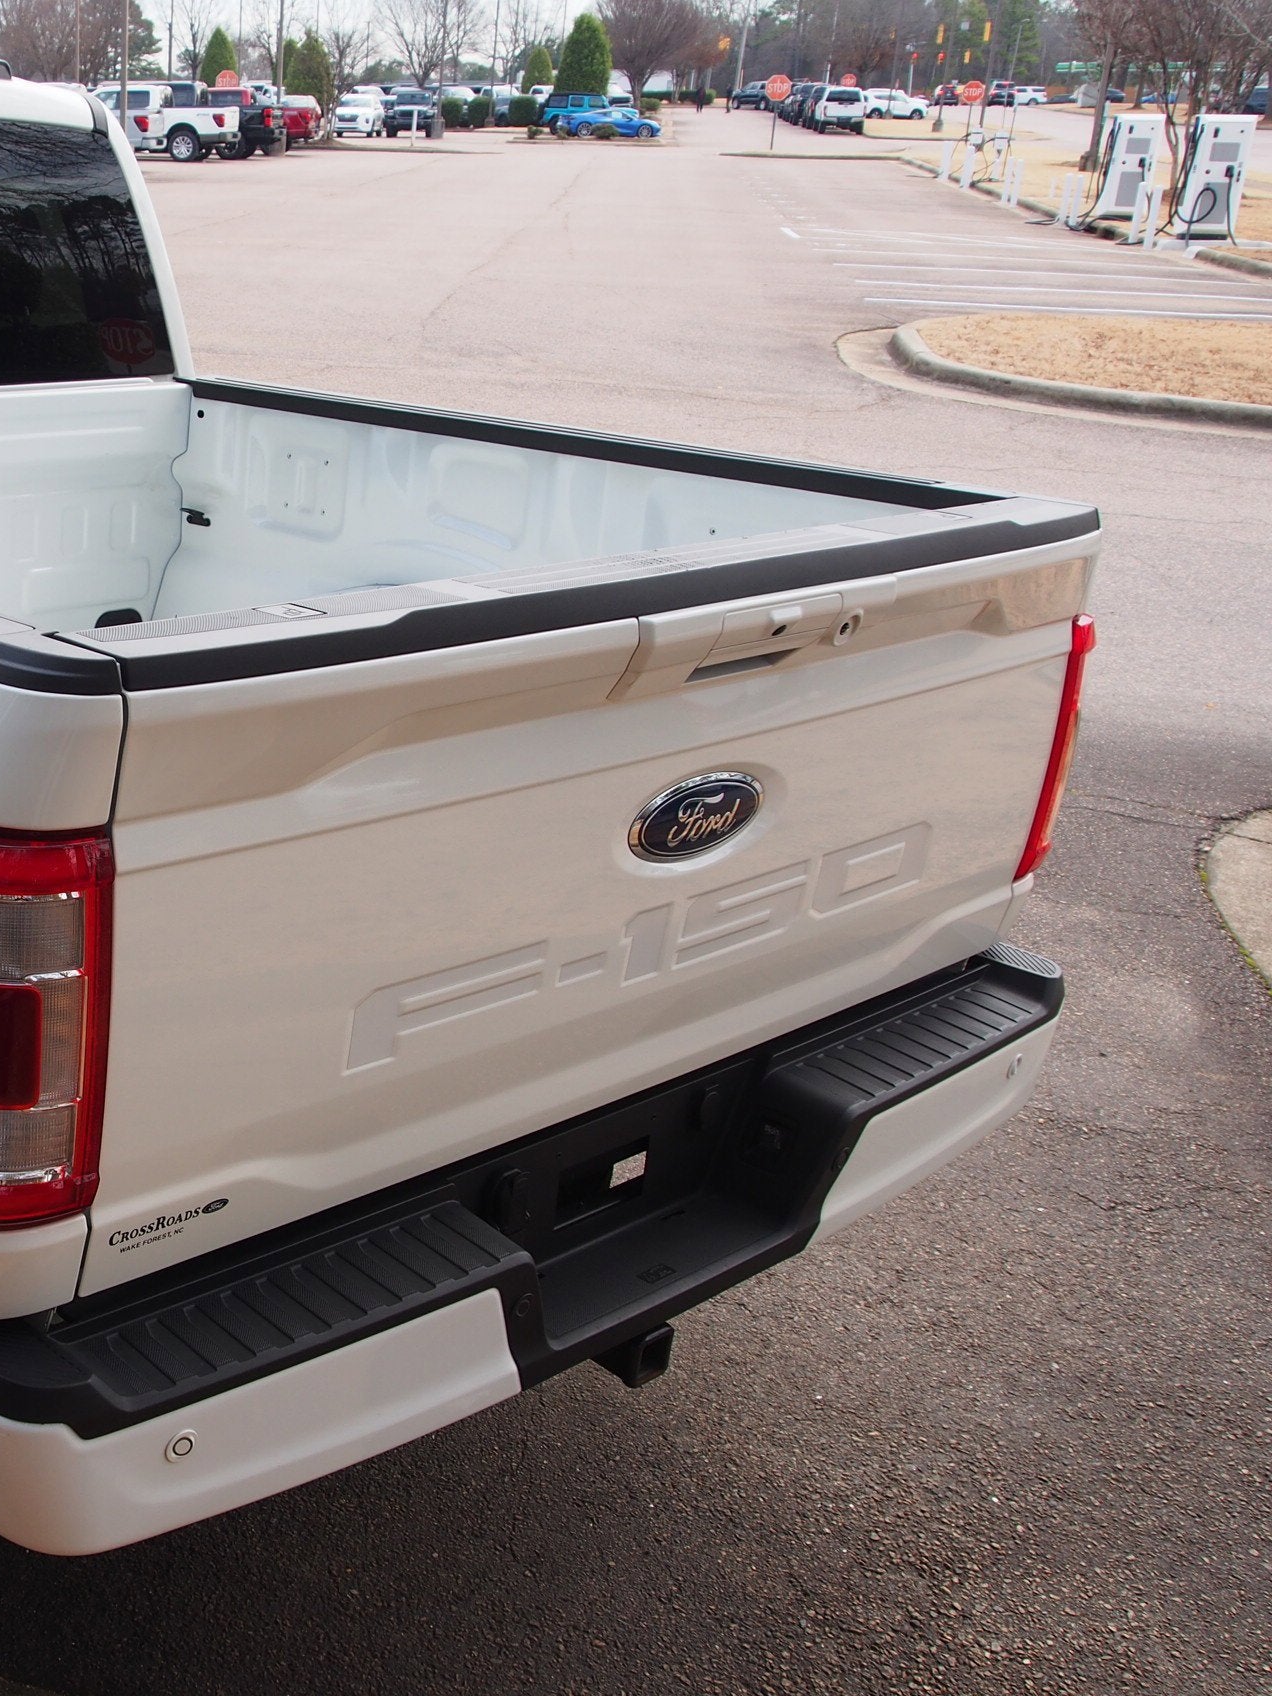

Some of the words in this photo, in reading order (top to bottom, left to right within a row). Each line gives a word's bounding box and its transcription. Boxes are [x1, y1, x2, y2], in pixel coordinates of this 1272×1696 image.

[767, 82, 789, 93] STOP
[963, 87, 983, 96] STOP
[667, 792, 740, 847] Ford
[341, 820, 932, 1075] F-150
[119, 1242, 140, 1253] WAKE
[143, 1231, 172, 1246] FOREST,
[174, 1227, 184, 1235] NC
